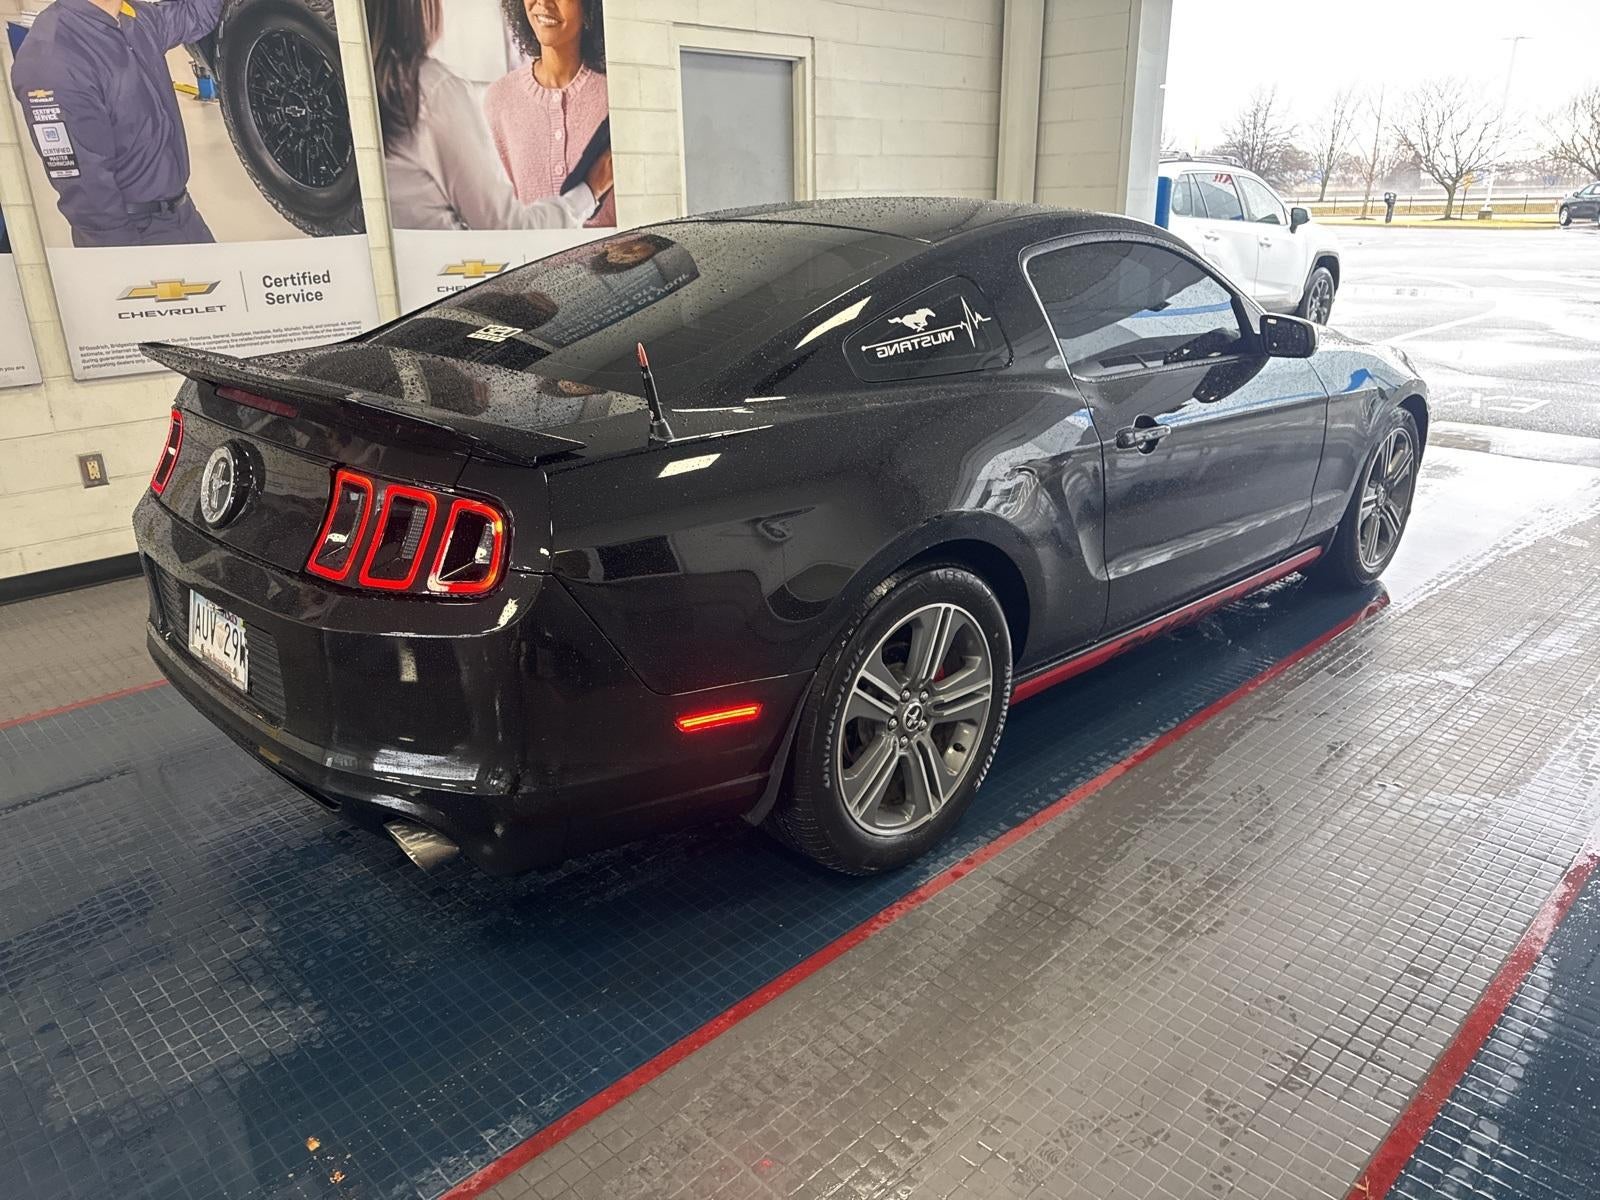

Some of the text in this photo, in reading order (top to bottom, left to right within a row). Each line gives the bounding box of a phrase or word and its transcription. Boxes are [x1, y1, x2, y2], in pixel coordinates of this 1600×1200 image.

[32, 107, 60, 116] CERTIFIED
[34, 113, 59, 121] SERVICE
[43, 147, 71, 155] CERTIFIED
[262, 270, 331, 289] Certified
[265, 288, 323, 306] Service
[118, 304, 226, 319] CHEVROLET
[195, 602, 216, 645] AUV
